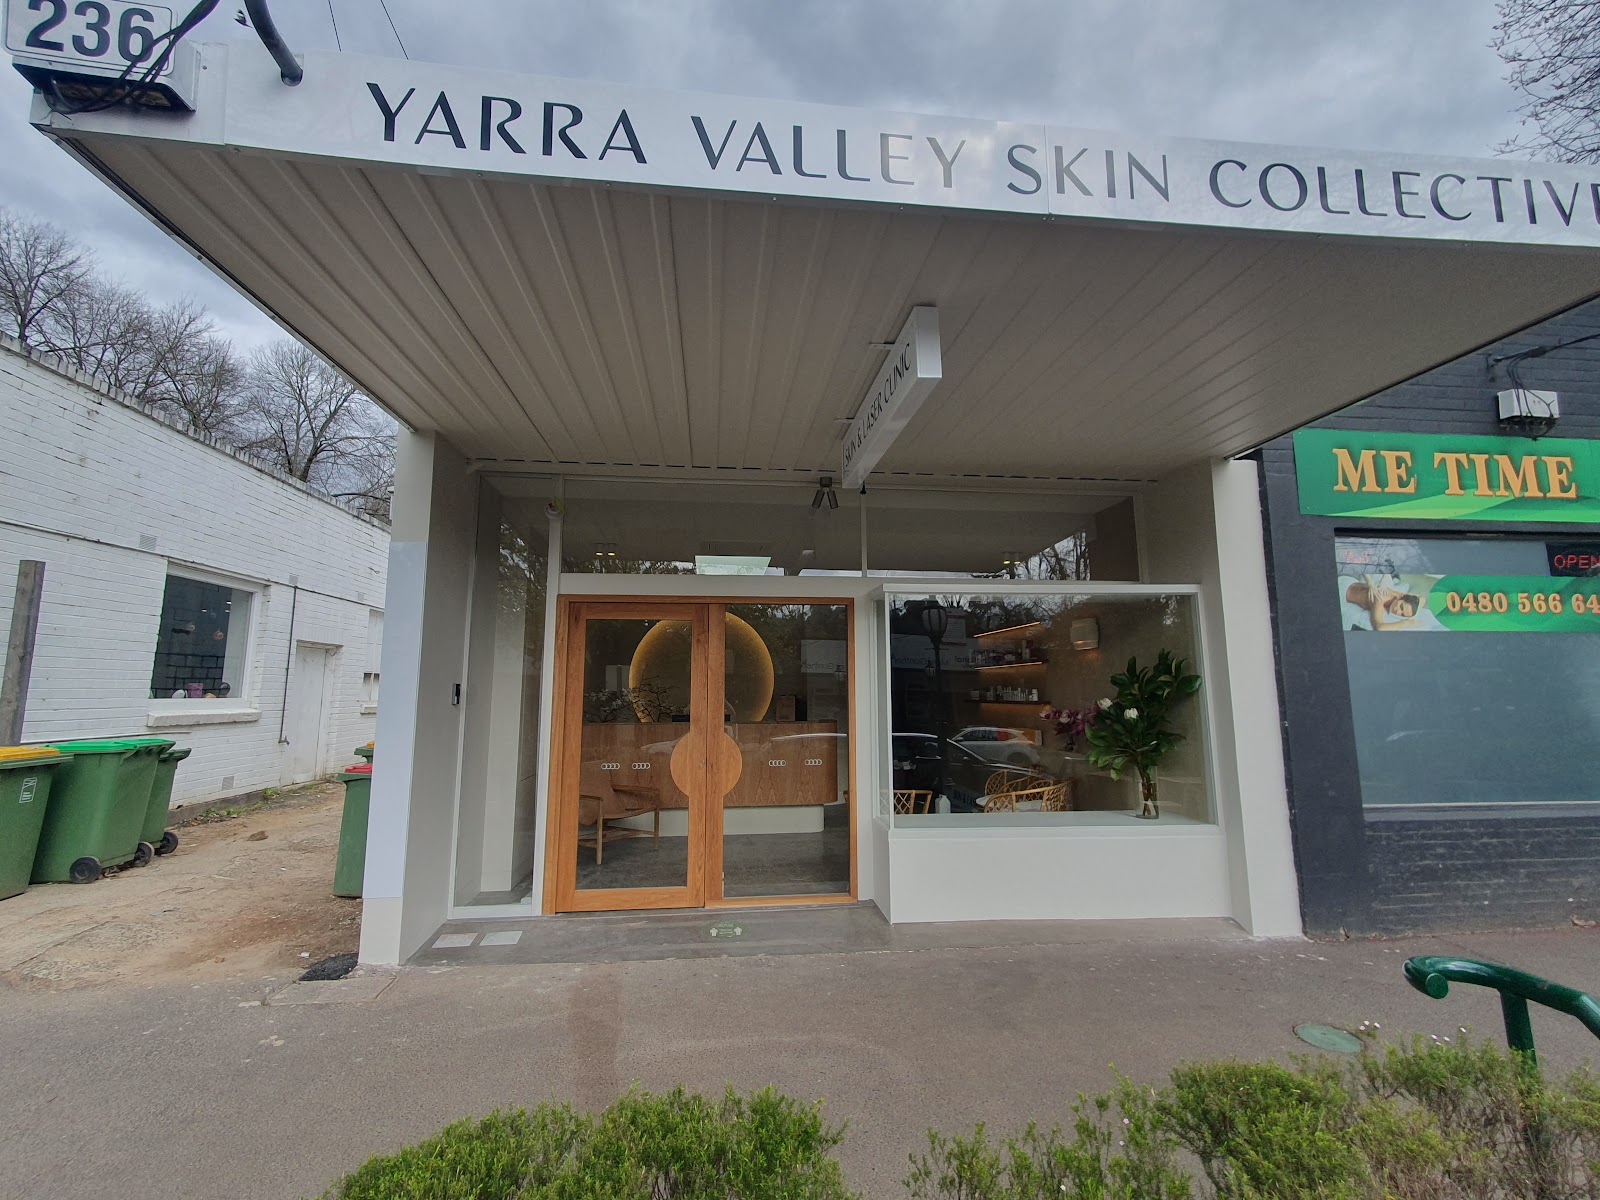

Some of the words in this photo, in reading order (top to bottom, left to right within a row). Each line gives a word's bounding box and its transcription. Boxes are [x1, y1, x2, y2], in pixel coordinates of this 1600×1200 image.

[25, 0, 155, 63] 236
[366, 82, 648, 165] YARRA
[690, 116, 966, 189] VALLEY
[1007, 144, 1170, 202] SKIN
[862, 392, 883, 439] LASER
[884, 342, 912, 404] CLINIC
[1332, 448, 1417, 494] ME
[1433, 452, 1578, 499] TIME
[1446, 592, 1509, 614] 0480
[1517, 592, 1564, 615] 566
